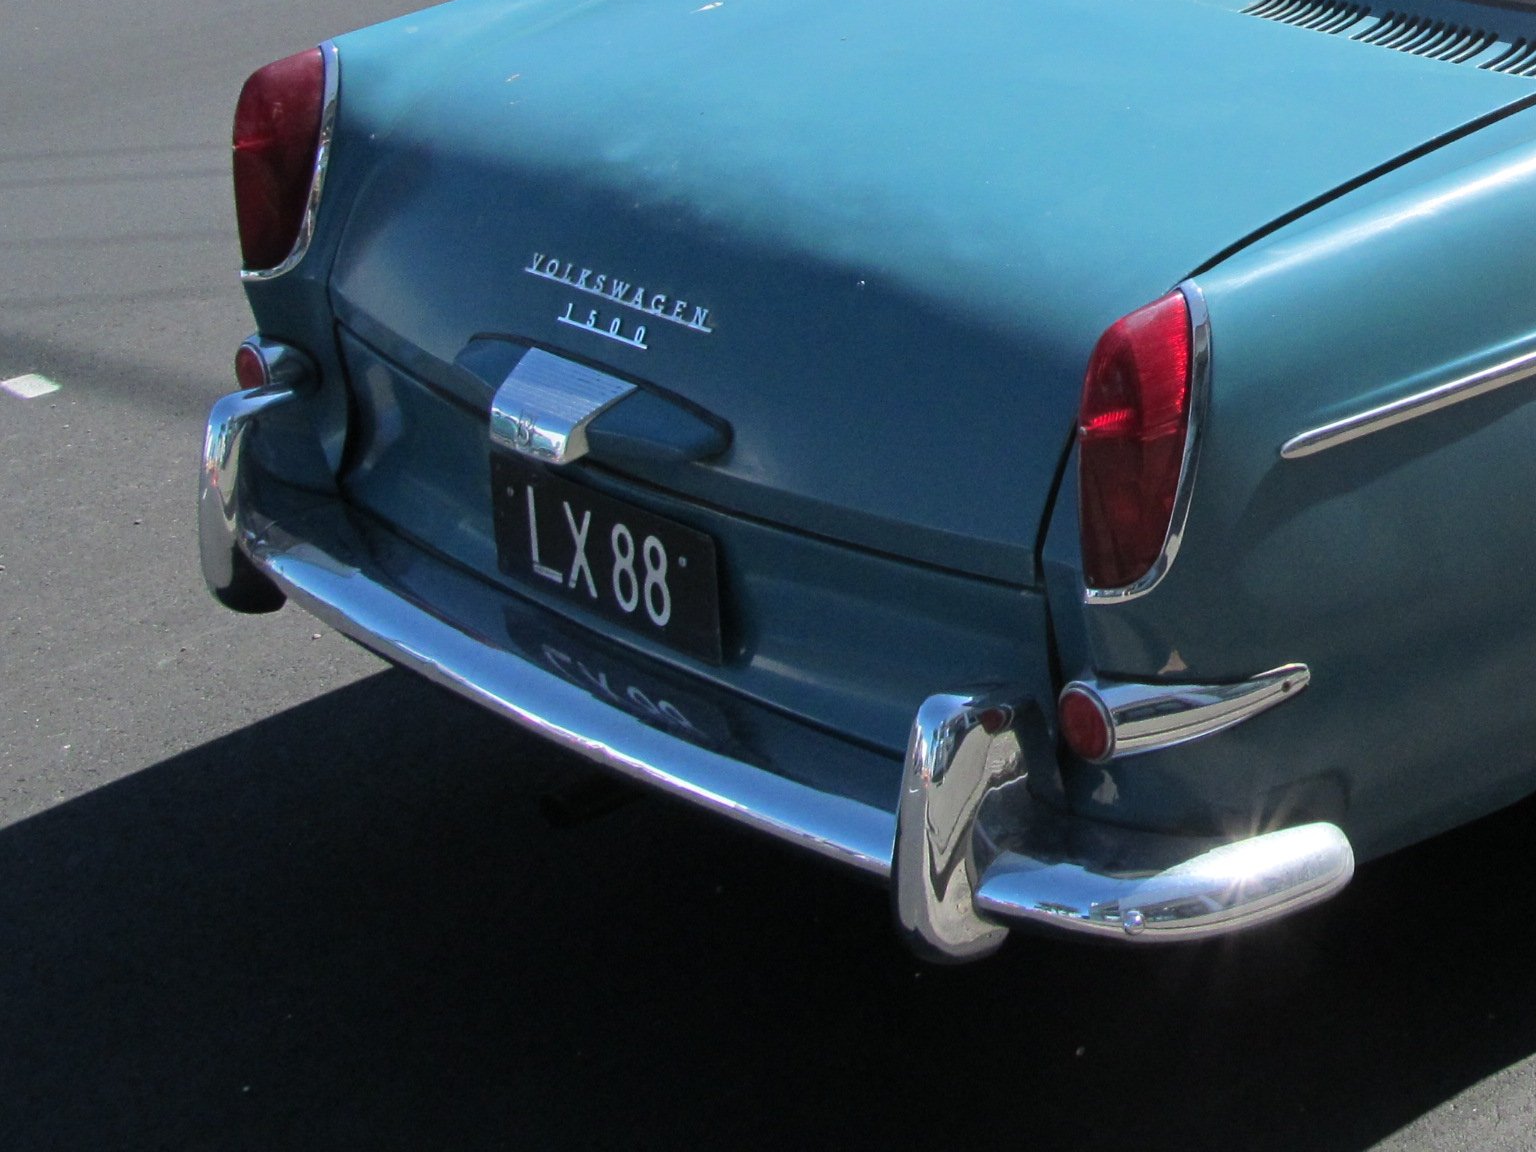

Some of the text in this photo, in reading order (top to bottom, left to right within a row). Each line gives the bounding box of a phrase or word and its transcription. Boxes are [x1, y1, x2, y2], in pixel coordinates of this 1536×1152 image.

[529, 251, 712, 330] VOLKSWAGEN
[562, 302, 646, 345] 1500
[526, 484, 673, 627] LX 88
